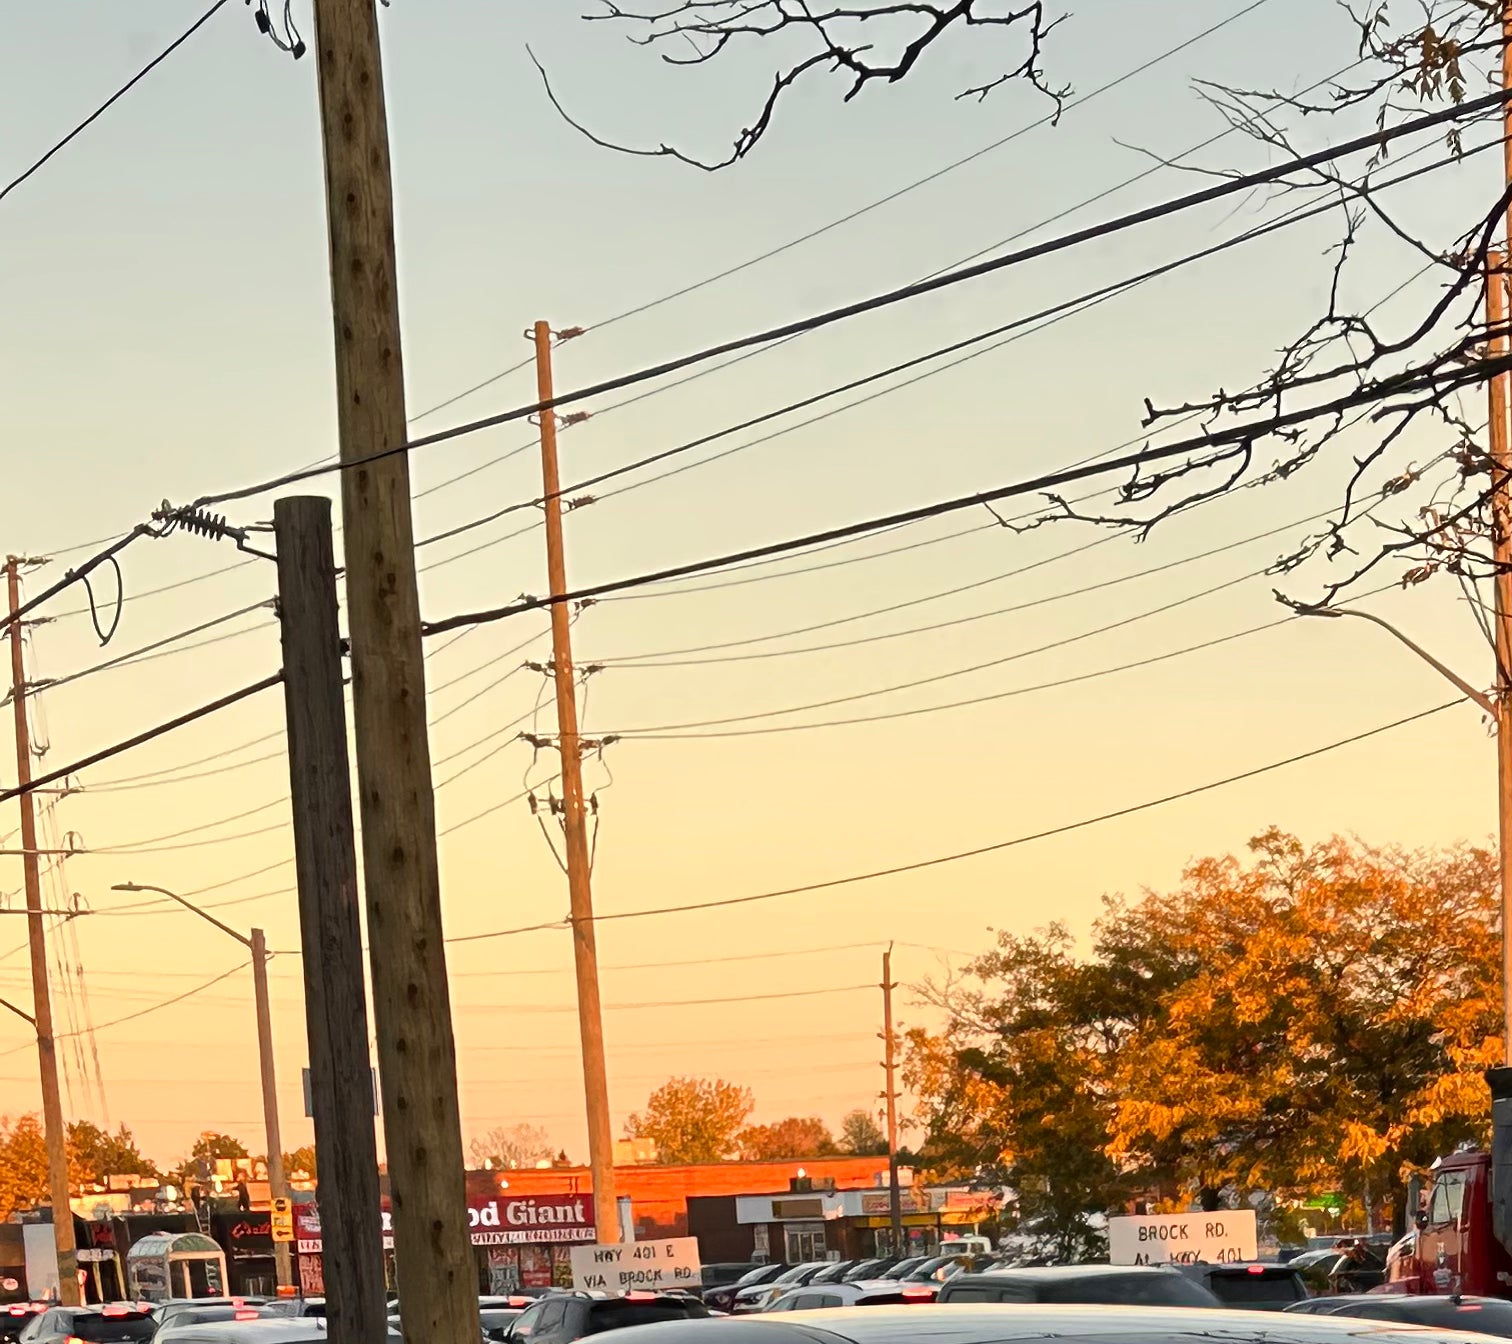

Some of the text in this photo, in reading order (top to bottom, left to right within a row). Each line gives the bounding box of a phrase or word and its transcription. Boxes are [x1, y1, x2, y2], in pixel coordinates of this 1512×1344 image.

[506, 1198, 586, 1225] Giant
[1138, 1222, 1228, 1242] BROCK RD.
[633, 1246, 656, 1259] 401
[666, 1244, 675, 1258] E
[584, 1275, 607, 1288] VIA
[619, 1269, 662, 1284] BROCK
